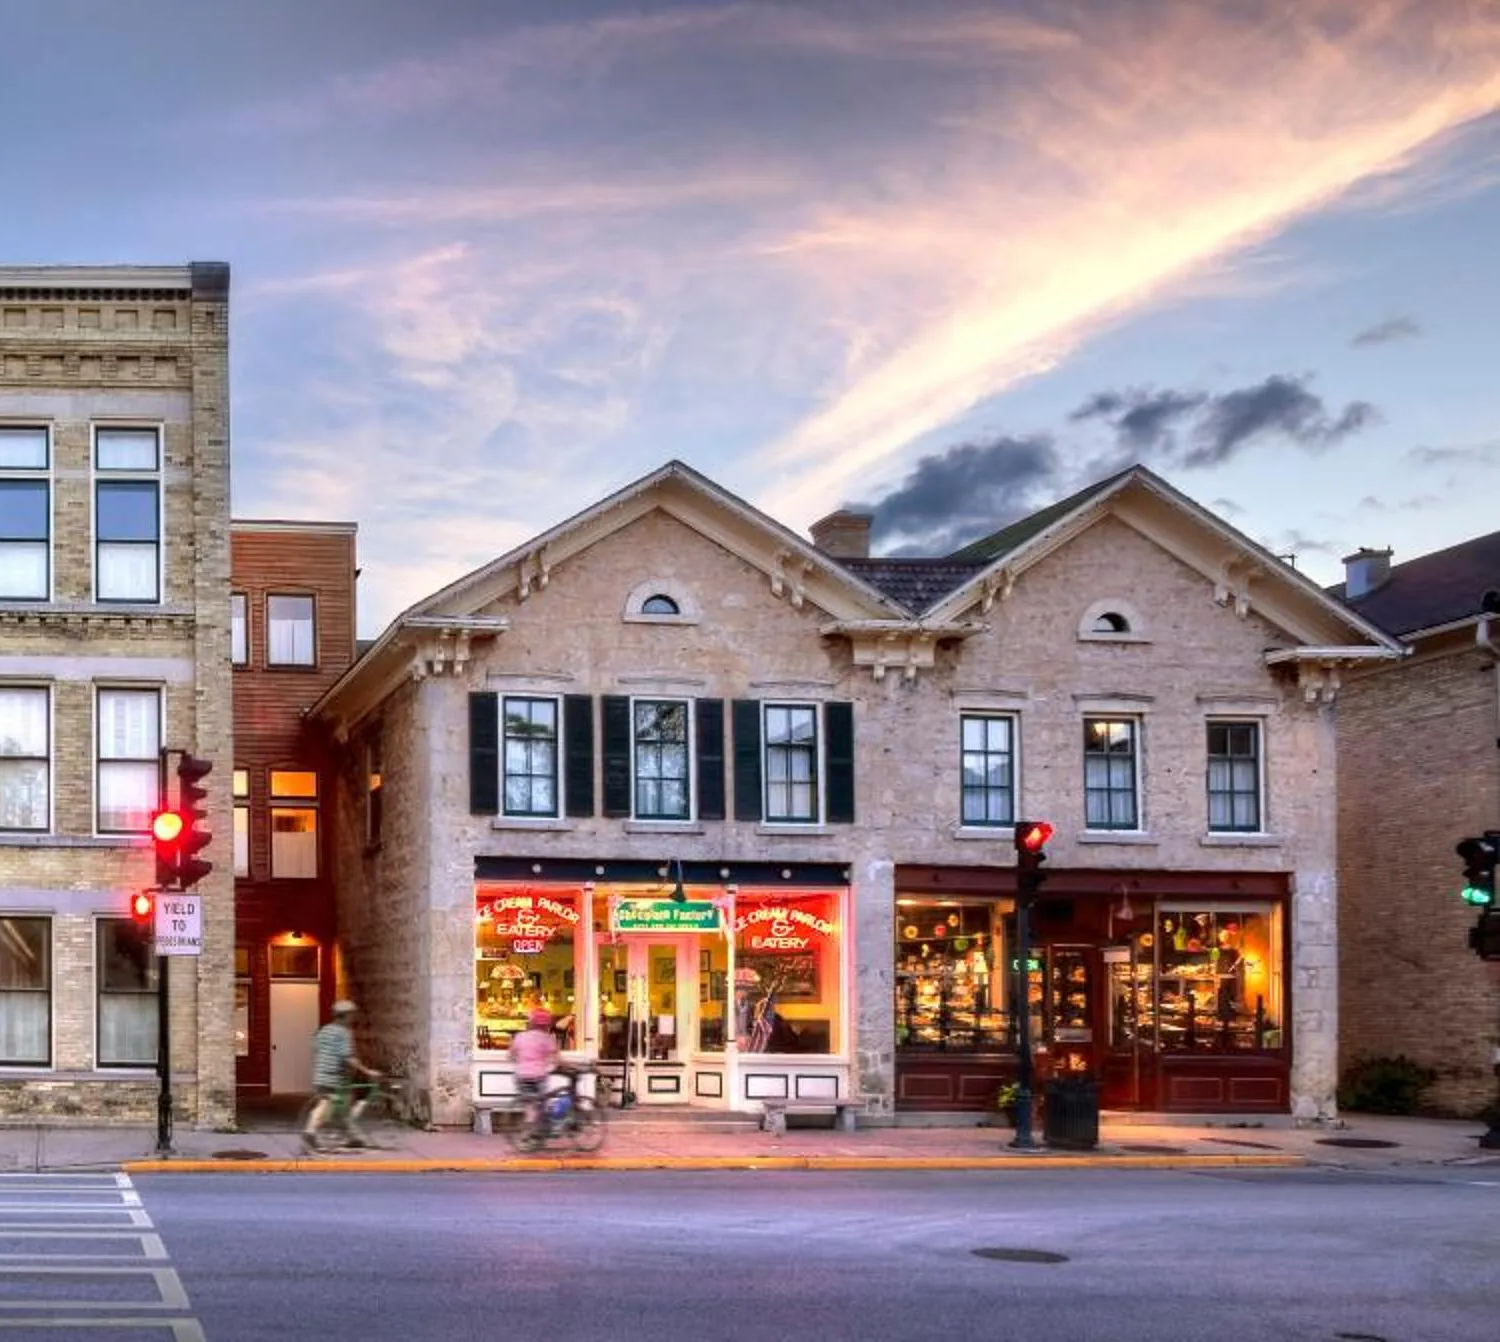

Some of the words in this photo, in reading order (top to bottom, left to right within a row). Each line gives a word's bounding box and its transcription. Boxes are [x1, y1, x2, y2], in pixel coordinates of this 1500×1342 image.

[164, 902, 195, 915] YIELD
[538, 897, 580, 924] PARLOR
[518, 908, 540, 926] &
[172, 919, 186, 932] TO
[497, 924, 556, 937] EATERY
[772, 919, 795, 937] &
[513, 940, 543, 952] OPEN
[752, 936, 809, 948] EATERY
